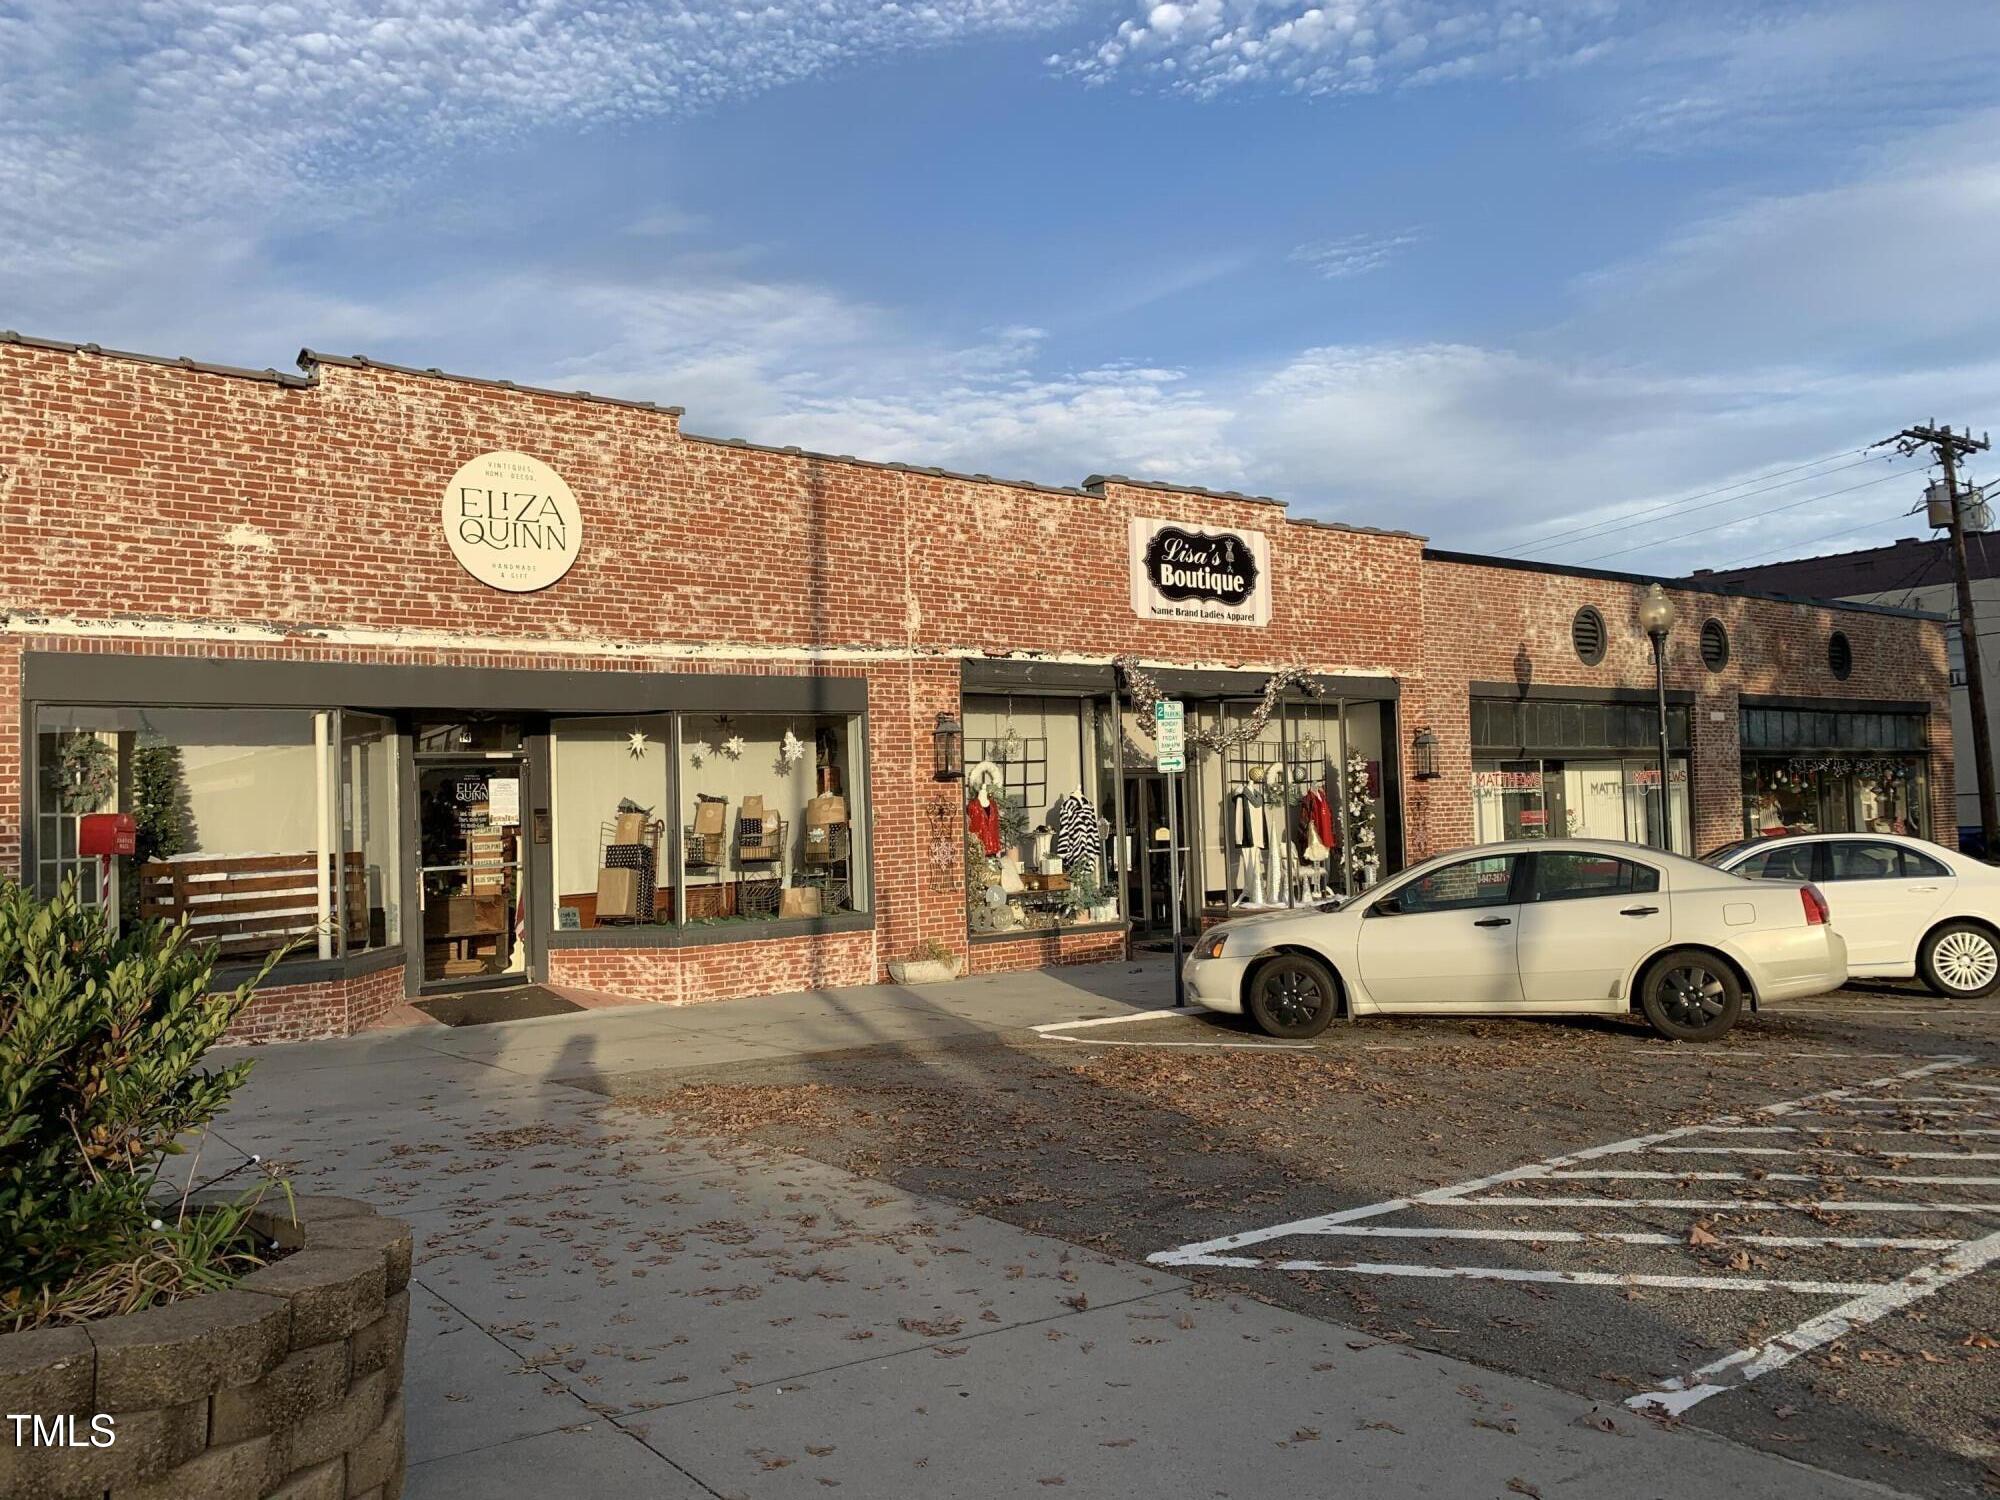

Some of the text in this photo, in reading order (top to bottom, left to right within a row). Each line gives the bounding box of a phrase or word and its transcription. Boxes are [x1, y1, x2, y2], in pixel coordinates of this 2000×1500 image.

[460, 487, 566, 525] ELIZA
[459, 518, 566, 551] QUINN
[1161, 538, 1221, 565] Lisa's
[1160, 563, 1244, 594] Boutique
[1151, 606, 1255, 622] Name Brand Ladies Apparel
[1158, 706, 1164, 717] 2
[1476, 772, 1541, 787] MATTHEWS
[1633, 769, 1687, 784] MATTEWS
[456, 782, 489, 793] ELIZA
[456, 791, 489, 802] QUINN
